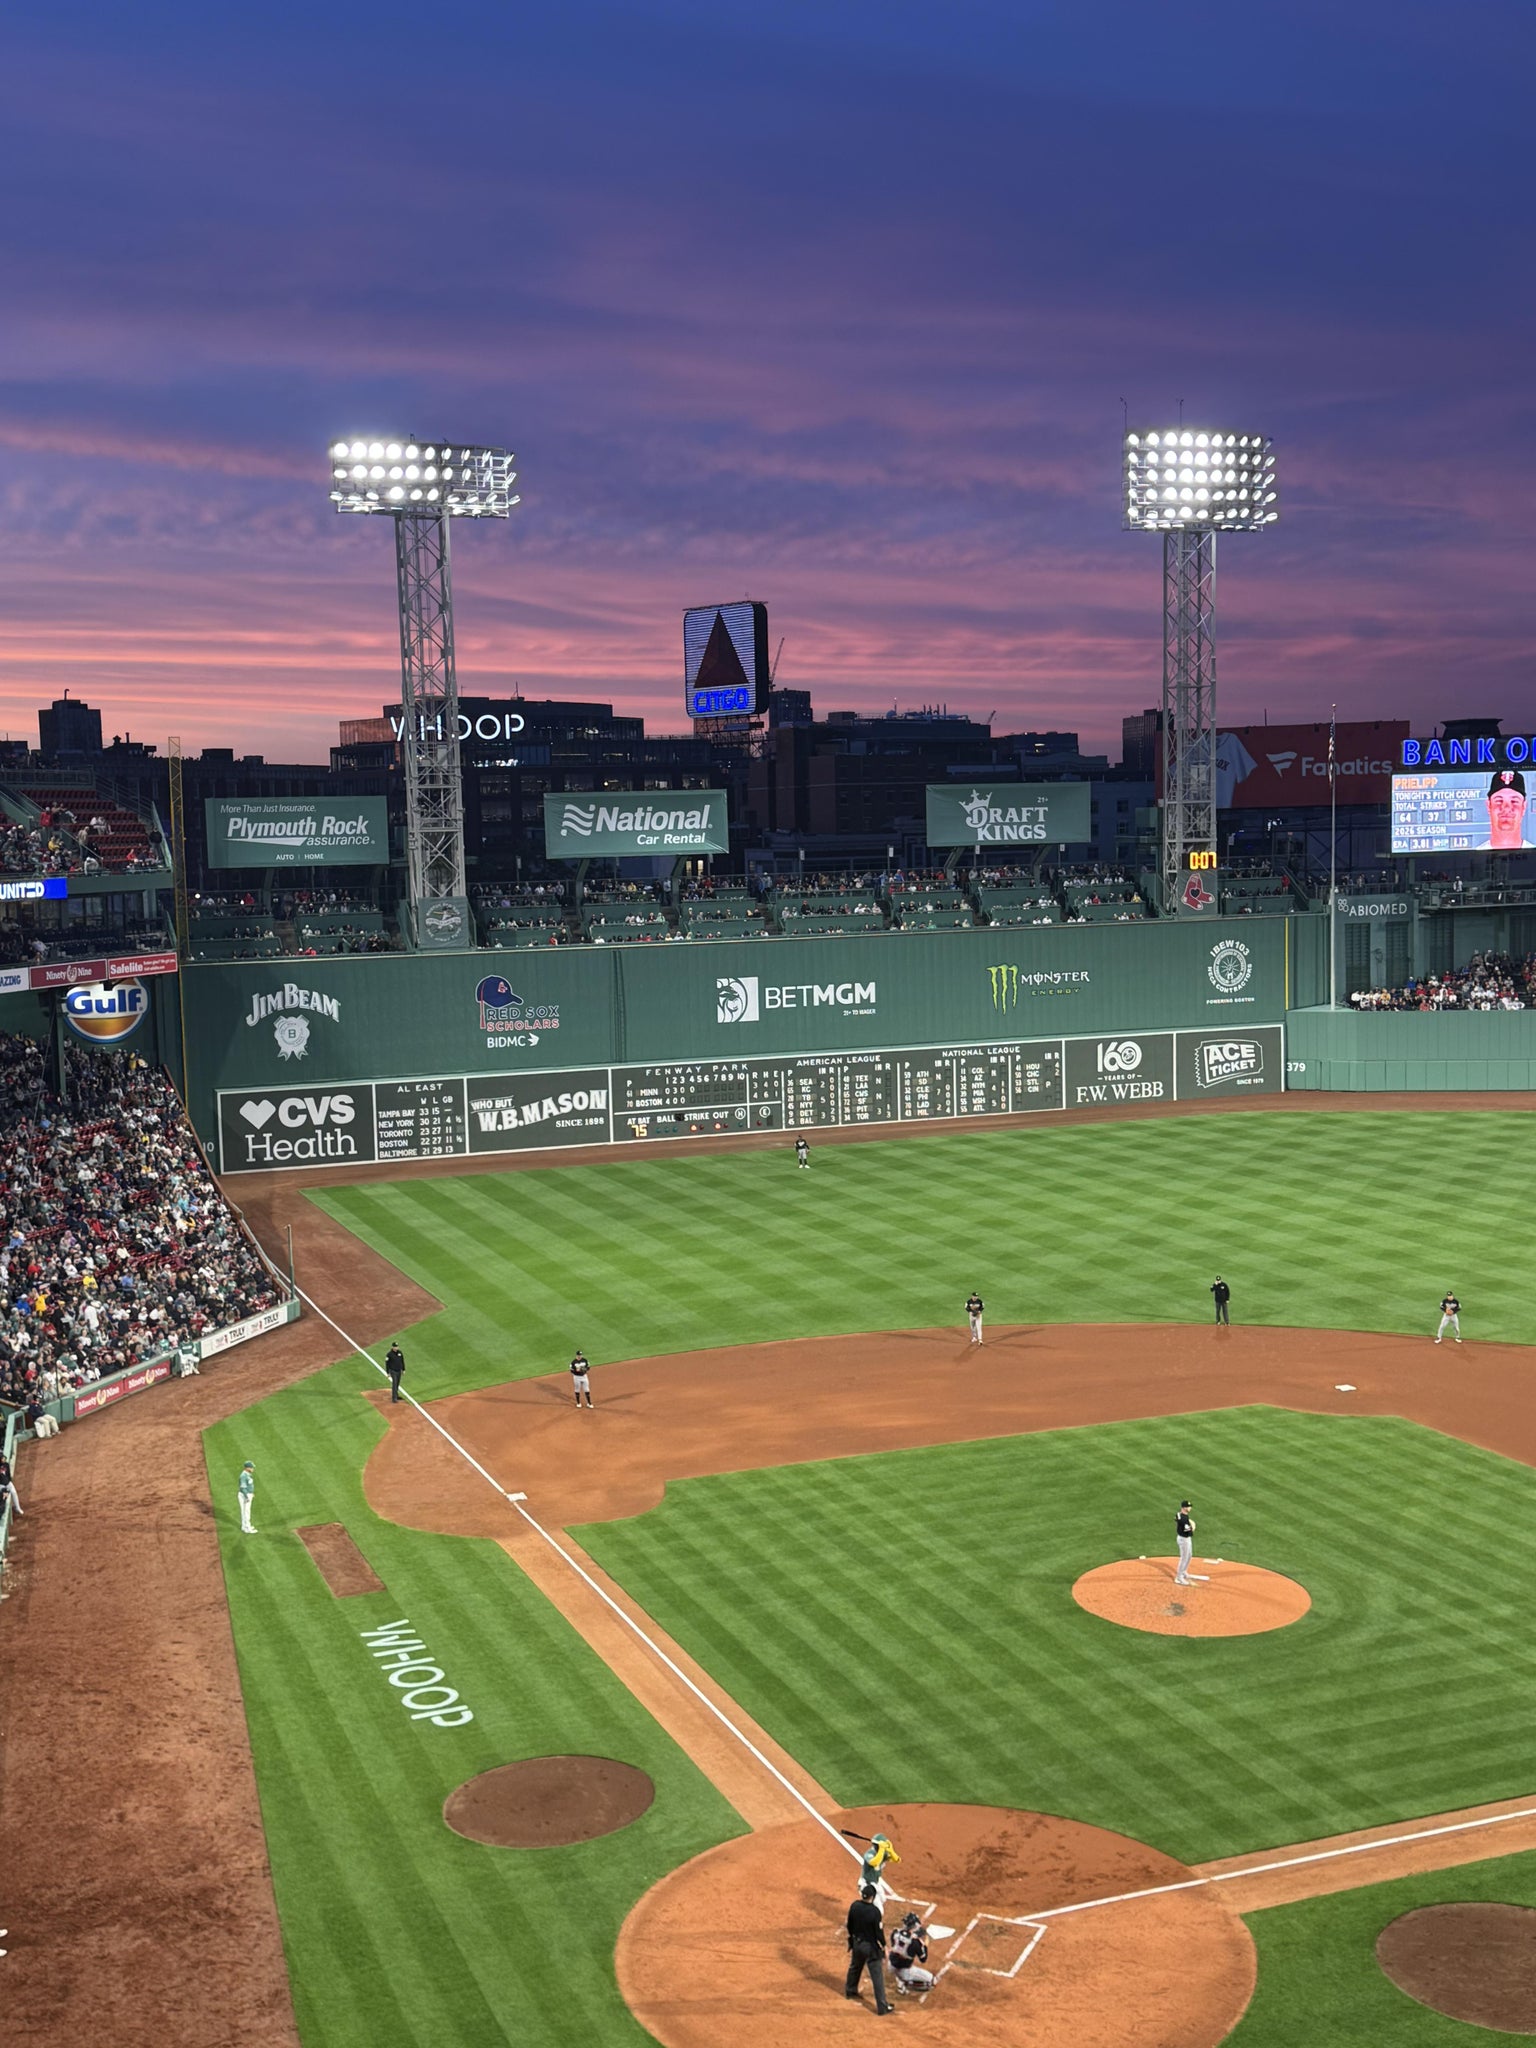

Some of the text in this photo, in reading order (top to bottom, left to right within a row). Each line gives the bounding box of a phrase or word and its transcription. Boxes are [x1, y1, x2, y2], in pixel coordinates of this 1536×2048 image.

[694, 687, 750, 711] CITGO
[1402, 736, 1536, 765] BANK O
[1302, 756, 1393, 777] Fanatics
[1394, 777, 1438, 790] PRIELIPP
[1395, 790, 1480, 801] TONIGHT'S PITCH COUNT
[220, 804, 317, 813] More Than Just Insurance.
[1395, 803, 1417, 811] TOTAL
[1420, 801, 1447, 809] STRIKES
[596, 804, 711, 832] National
[965, 806, 1048, 828] DRAFT
[1400, 811, 1467, 822] 64 37 58
[227, 815, 369, 839] Plymouth Rock
[977, 824, 1046, 841] KINGS
[1394, 826, 1447, 836] 2026 SEASON
[306, 836, 370, 846] assurance
[637, 832, 706, 845] Car Rental
[1393, 840, 1408, 849] ERA
[1453, 837, 1468, 848] 1.13
[1189, 851, 1217, 870] 0:07
[0, 882, 45, 899] UNITED
[1349, 903, 1408, 917] ABIOMED
[46, 971, 66, 981] Ninety
[77, 967, 93, 977] Nine
[110, 962, 143, 975] Safelite
[1021, 971, 1090, 985] MONSTER
[66, 988, 142, 1015] Gulf
[765, 981, 876, 1009] BETMGM
[245, 983, 340, 1027] JIM BEAM
[486, 1005, 560, 1020] RED SOX
[486, 1018, 560, 1032] SCHOLARS
[487, 1035, 526, 1048] BIDMC
[942, 1046, 1021, 1057] NATIONAL LEAGUE
[1097, 1041, 1142, 1072] 160
[1209, 1043, 1256, 1065] ACE
[796, 1055, 881, 1067] AMERICAN LEAGUE
[1286, 1062, 1306, 1072] 379
[646, 1063, 748, 1076] FENWAY PARK
[916, 1070, 929, 1078] ATH
[1026, 1070, 1040, 1078] CHC
[1209, 1059, 1256, 1077] TICKET
[397, 1083, 443, 1093] AL EAST
[640, 1088, 659, 1096] MINN
[855, 1082, 869, 1090] LAA
[916, 1085, 930, 1093] CLE
[1076, 1081, 1164, 1103] F.W. WEBB
[420, 1097, 427, 1105] W
[470, 1098, 513, 1111] WHO BUT
[635, 1098, 663, 1107] BOSTON
[799, 1101, 813, 1109] NYY
[916, 1101, 930, 1109] LAD
[278, 1094, 356, 1128] CVS
[378, 1107, 440, 1119] TAMPA BAY 33 15
[856, 1105, 868, 1113] PIT
[973, 1104, 985, 1112] ATL
[378, 1121, 394, 1129] NEW
[395, 1119, 414, 1127] YORK
[420, 1118, 430, 1126] 30
[432, 1117, 441, 1125] 21
[445, 1116, 451, 1124] 4
[555, 1117, 605, 1128] SINCE 1898
[627, 1118, 636, 1126] AT
[656, 1115, 676, 1123] BALL
[683, 1112, 710, 1122] STRIKE
[712, 1111, 729, 1119] OUT
[800, 1117, 814, 1125] BAL
[379, 1126, 452, 1138] TORONTO 23 27 11
[631, 1124, 648, 1138] 75
[245, 1128, 358, 1162] Health
[379, 1140, 409, 1148] BOSTON
[420, 1138, 430, 1146] 22
[432, 1137, 442, 1145] 27
[446, 1136, 453, 1144] 11
[379, 1149, 418, 1158] BALTIMORE
[422, 1147, 430, 1155] 21
[432, 1147, 442, 1155] 29
[263, 1312, 279, 1325] TRULY
[229, 1327, 245, 1340] TRULY
[128, 1367, 168, 1389] Ninety Nine
[78, 1387, 120, 1410] Ninety Nine
[360, 1618, 474, 1727] WHOOP
